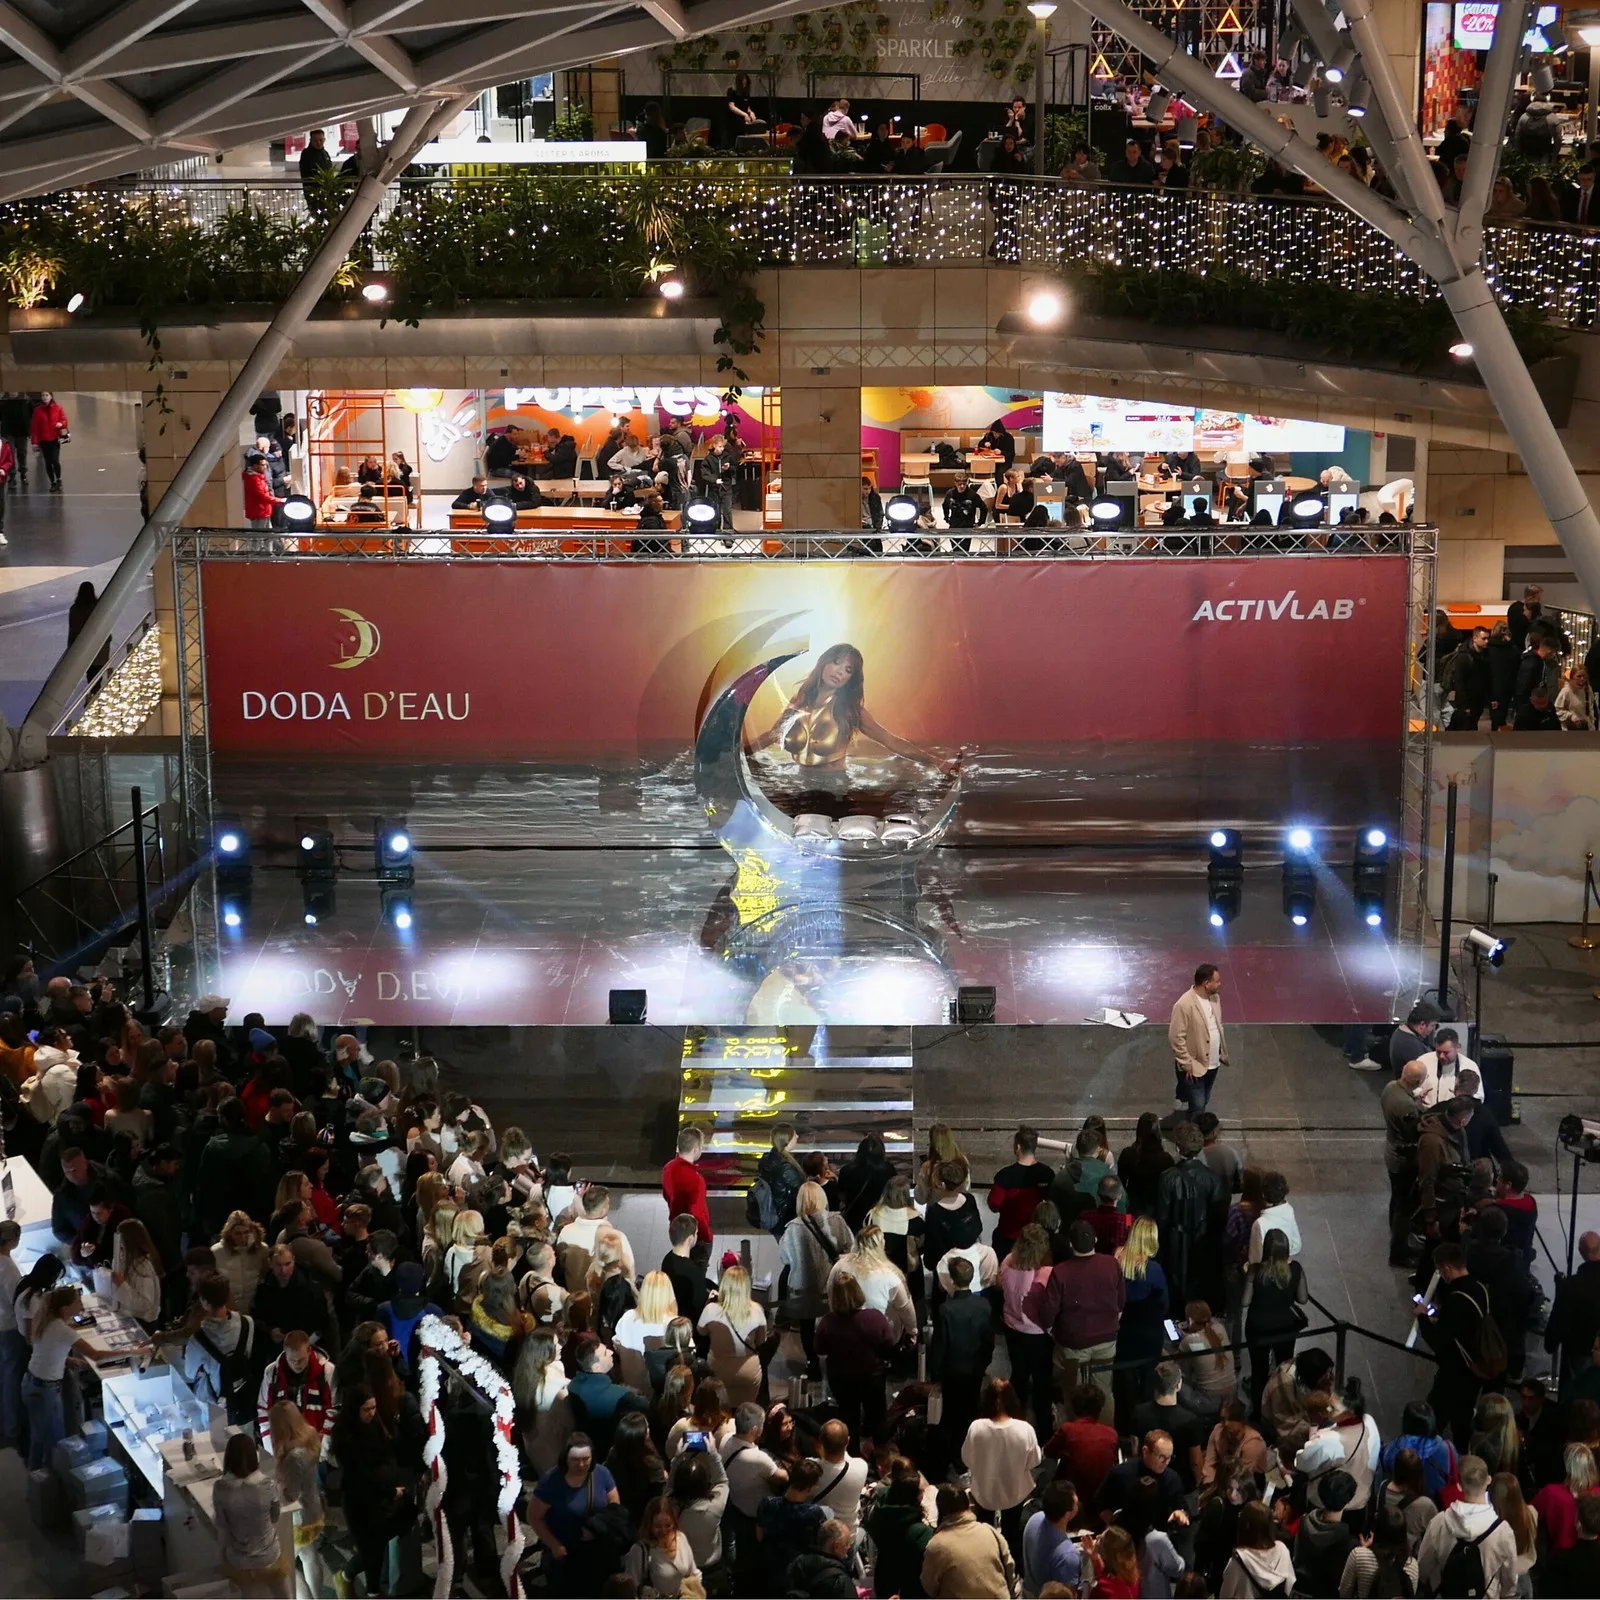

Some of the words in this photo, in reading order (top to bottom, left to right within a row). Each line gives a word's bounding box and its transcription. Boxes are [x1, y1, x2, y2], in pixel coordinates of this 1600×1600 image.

[876, 38, 954, 58] SPARKLE
[1192, 590, 1355, 621] ACTIVLAB
[242, 691, 352, 720] DODA
[363, 691, 470, 720] D'EAU
